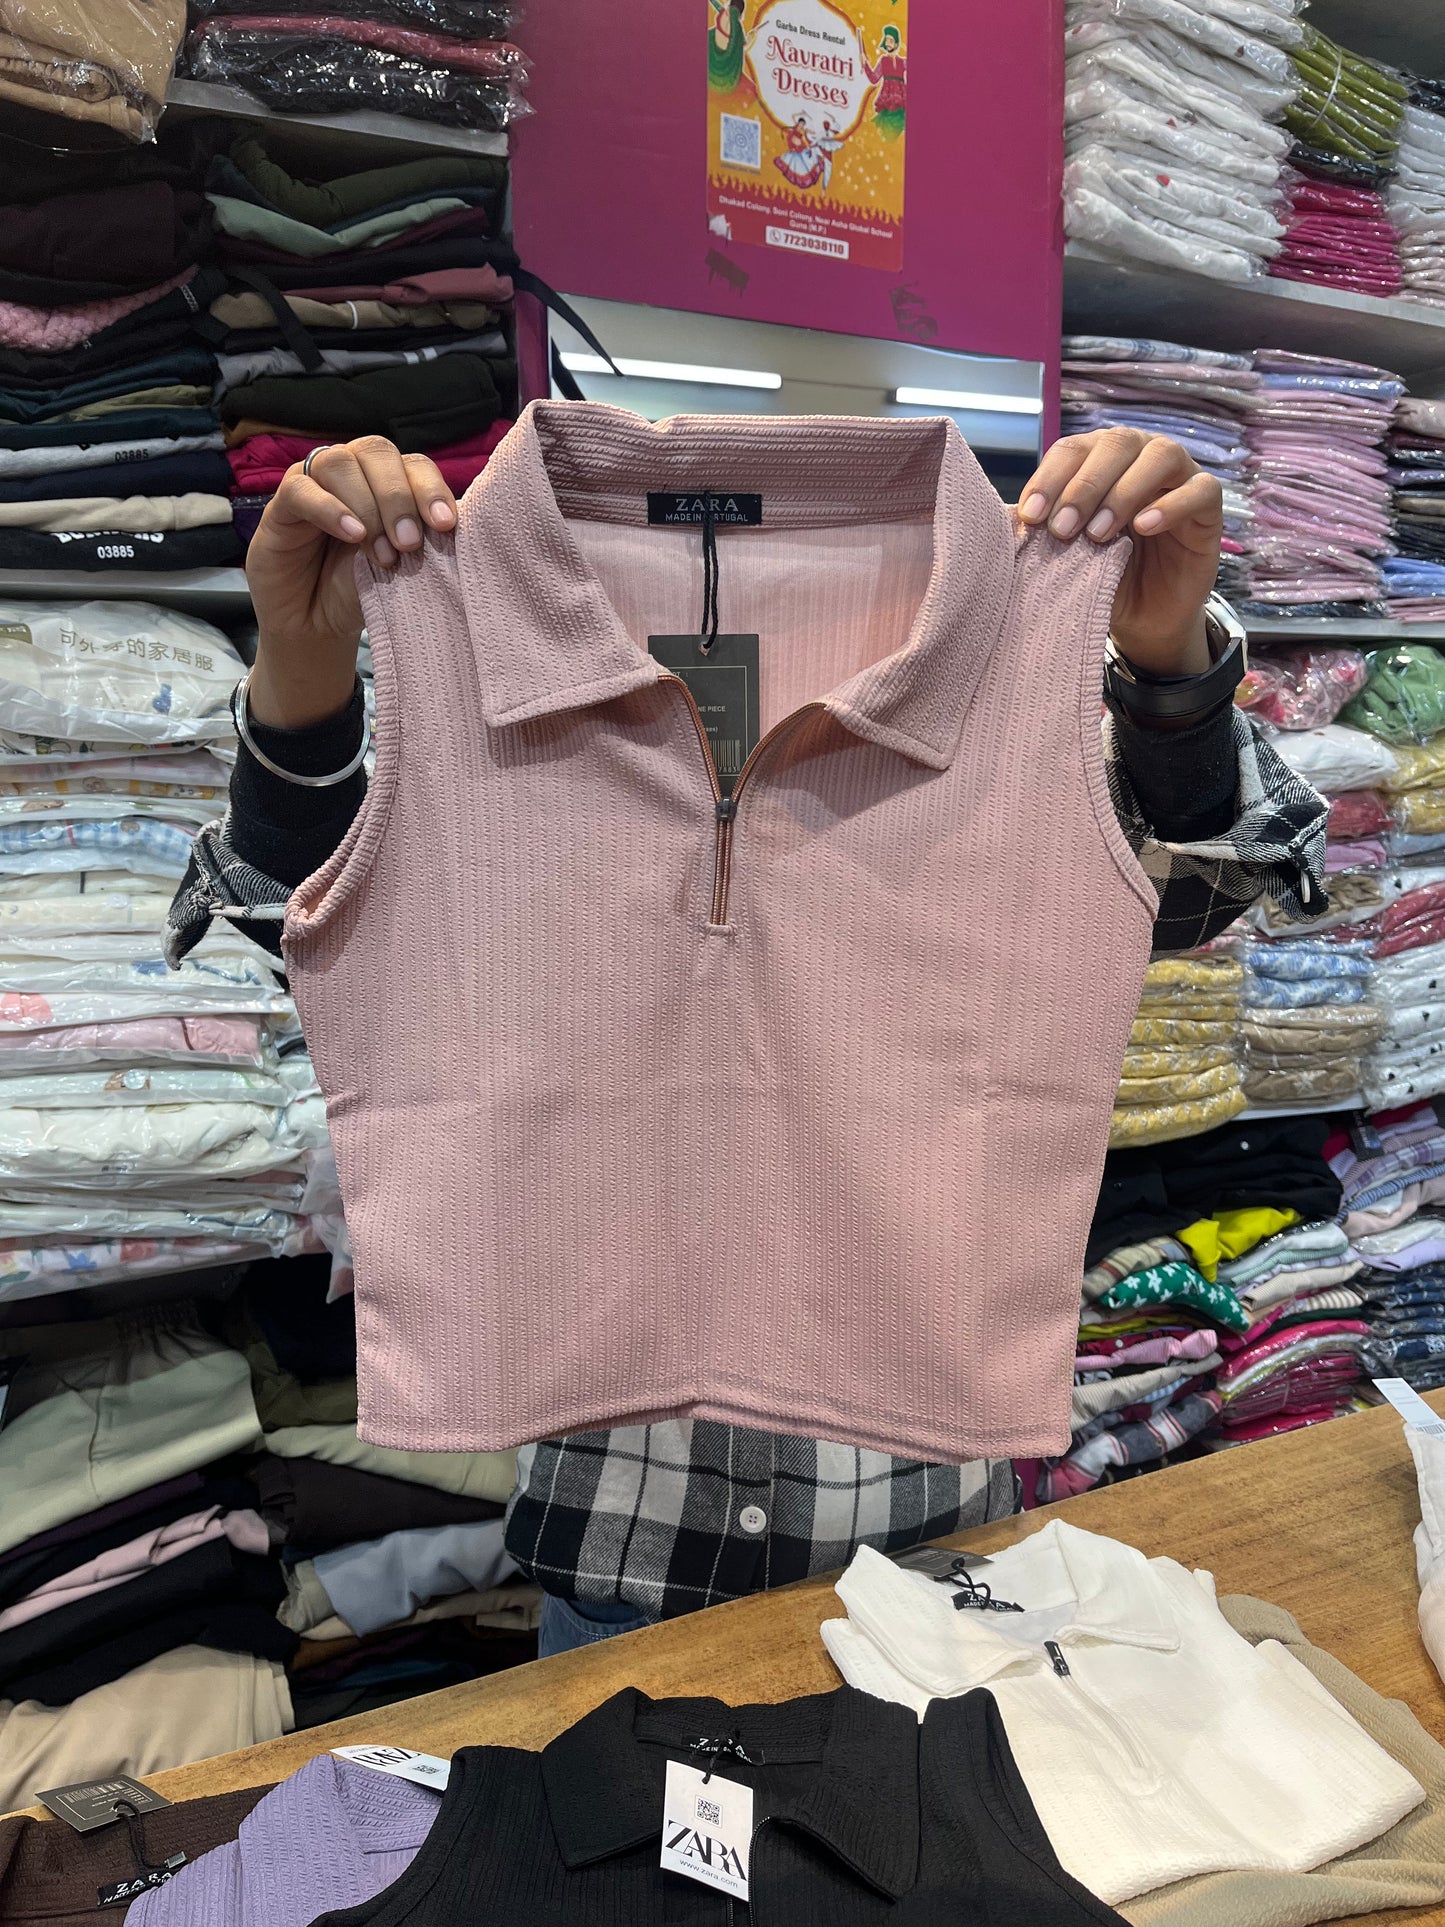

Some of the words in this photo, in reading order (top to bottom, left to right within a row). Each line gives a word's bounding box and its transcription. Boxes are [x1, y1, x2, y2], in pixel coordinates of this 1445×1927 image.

[776, 19, 798, 33] Garba
[799, 25, 821, 39] Dress
[822, 31, 846, 46] Rental
[767, 35, 854, 78] Navratri
[772, 67, 849, 107] Dresses
[783, 232, 845, 255] 7723038110
[870, 226, 894, 239] School
[115, 449, 149, 462] 03885
[675, 498, 739, 512] ZARA
[665, 513, 692, 521] MADE
[704, 513, 748, 522] RTUGAL
[97, 545, 135, 559] 03885
[697, 705, 707, 713] NE
[707, 705, 726, 713] PIECE
[665, 1819, 748, 1882] ZARA
[116, 1872, 174, 1894] ZARA
[679, 1858, 739, 1889] www.zara.com
